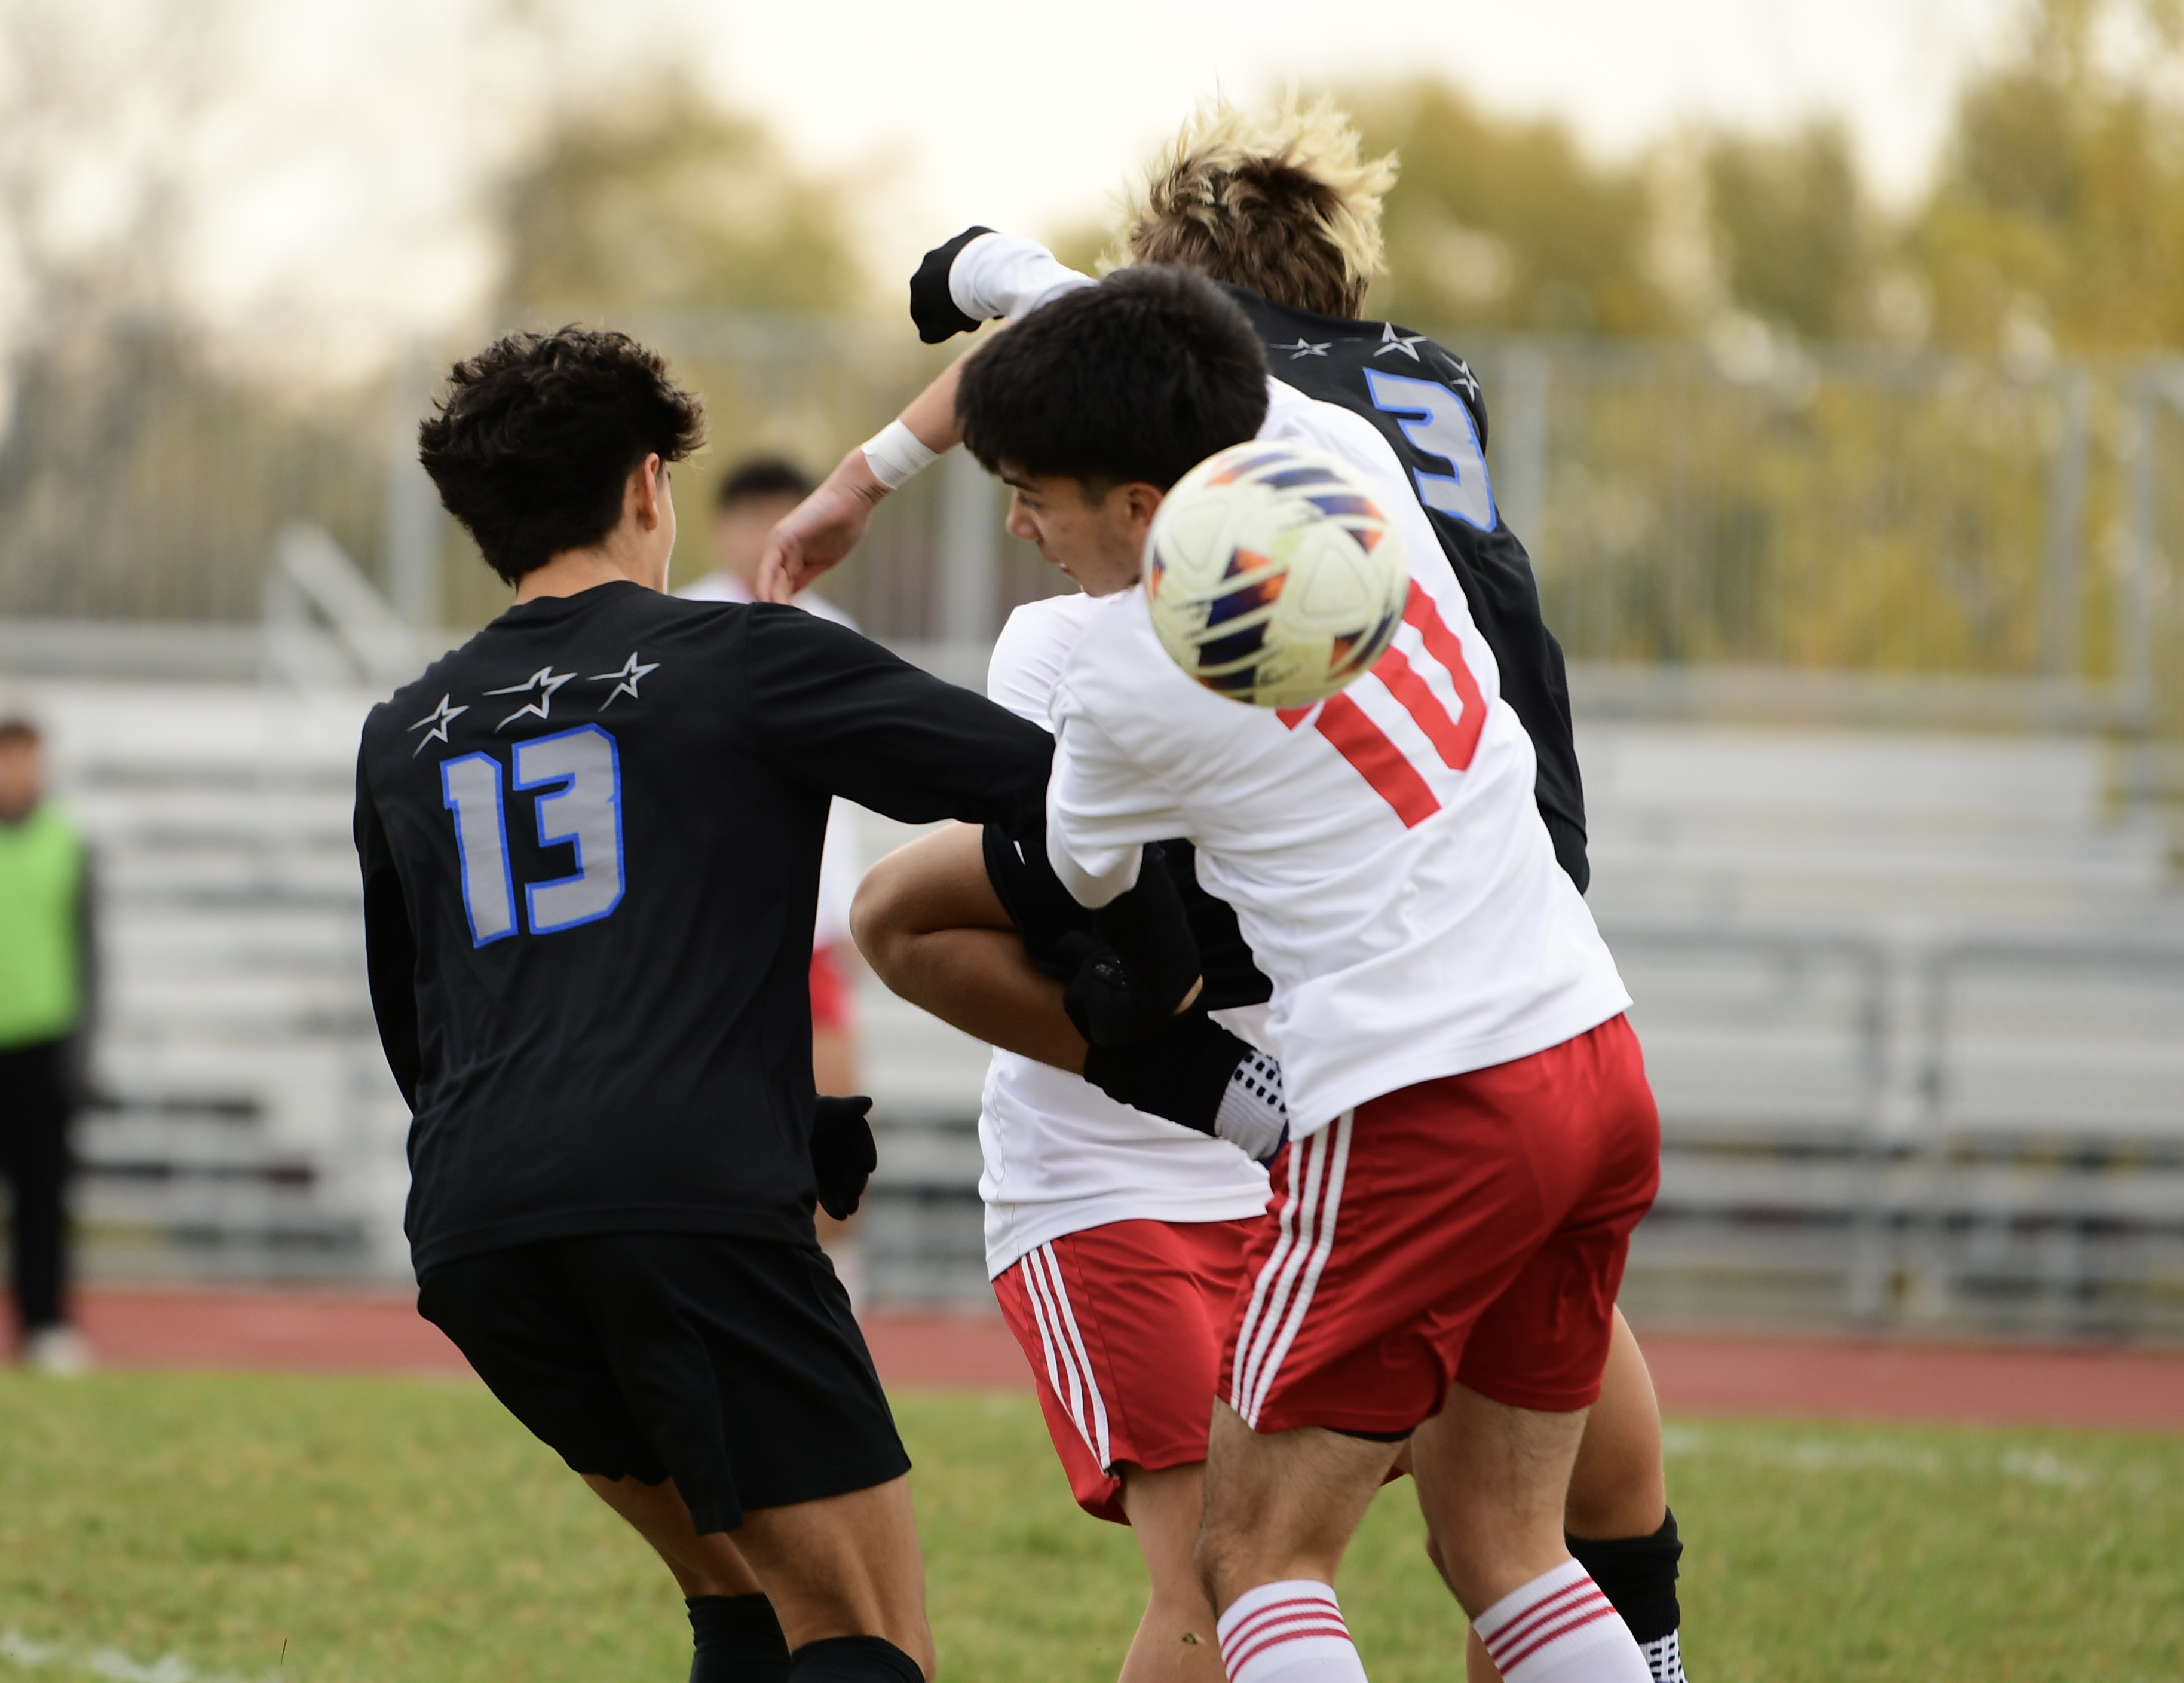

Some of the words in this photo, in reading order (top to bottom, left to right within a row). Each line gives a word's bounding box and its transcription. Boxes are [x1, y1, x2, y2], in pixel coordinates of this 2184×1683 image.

[1363, 366, 1497, 533] 3
[1275, 577, 1488, 829] 10
[440, 723, 626, 948] 13
